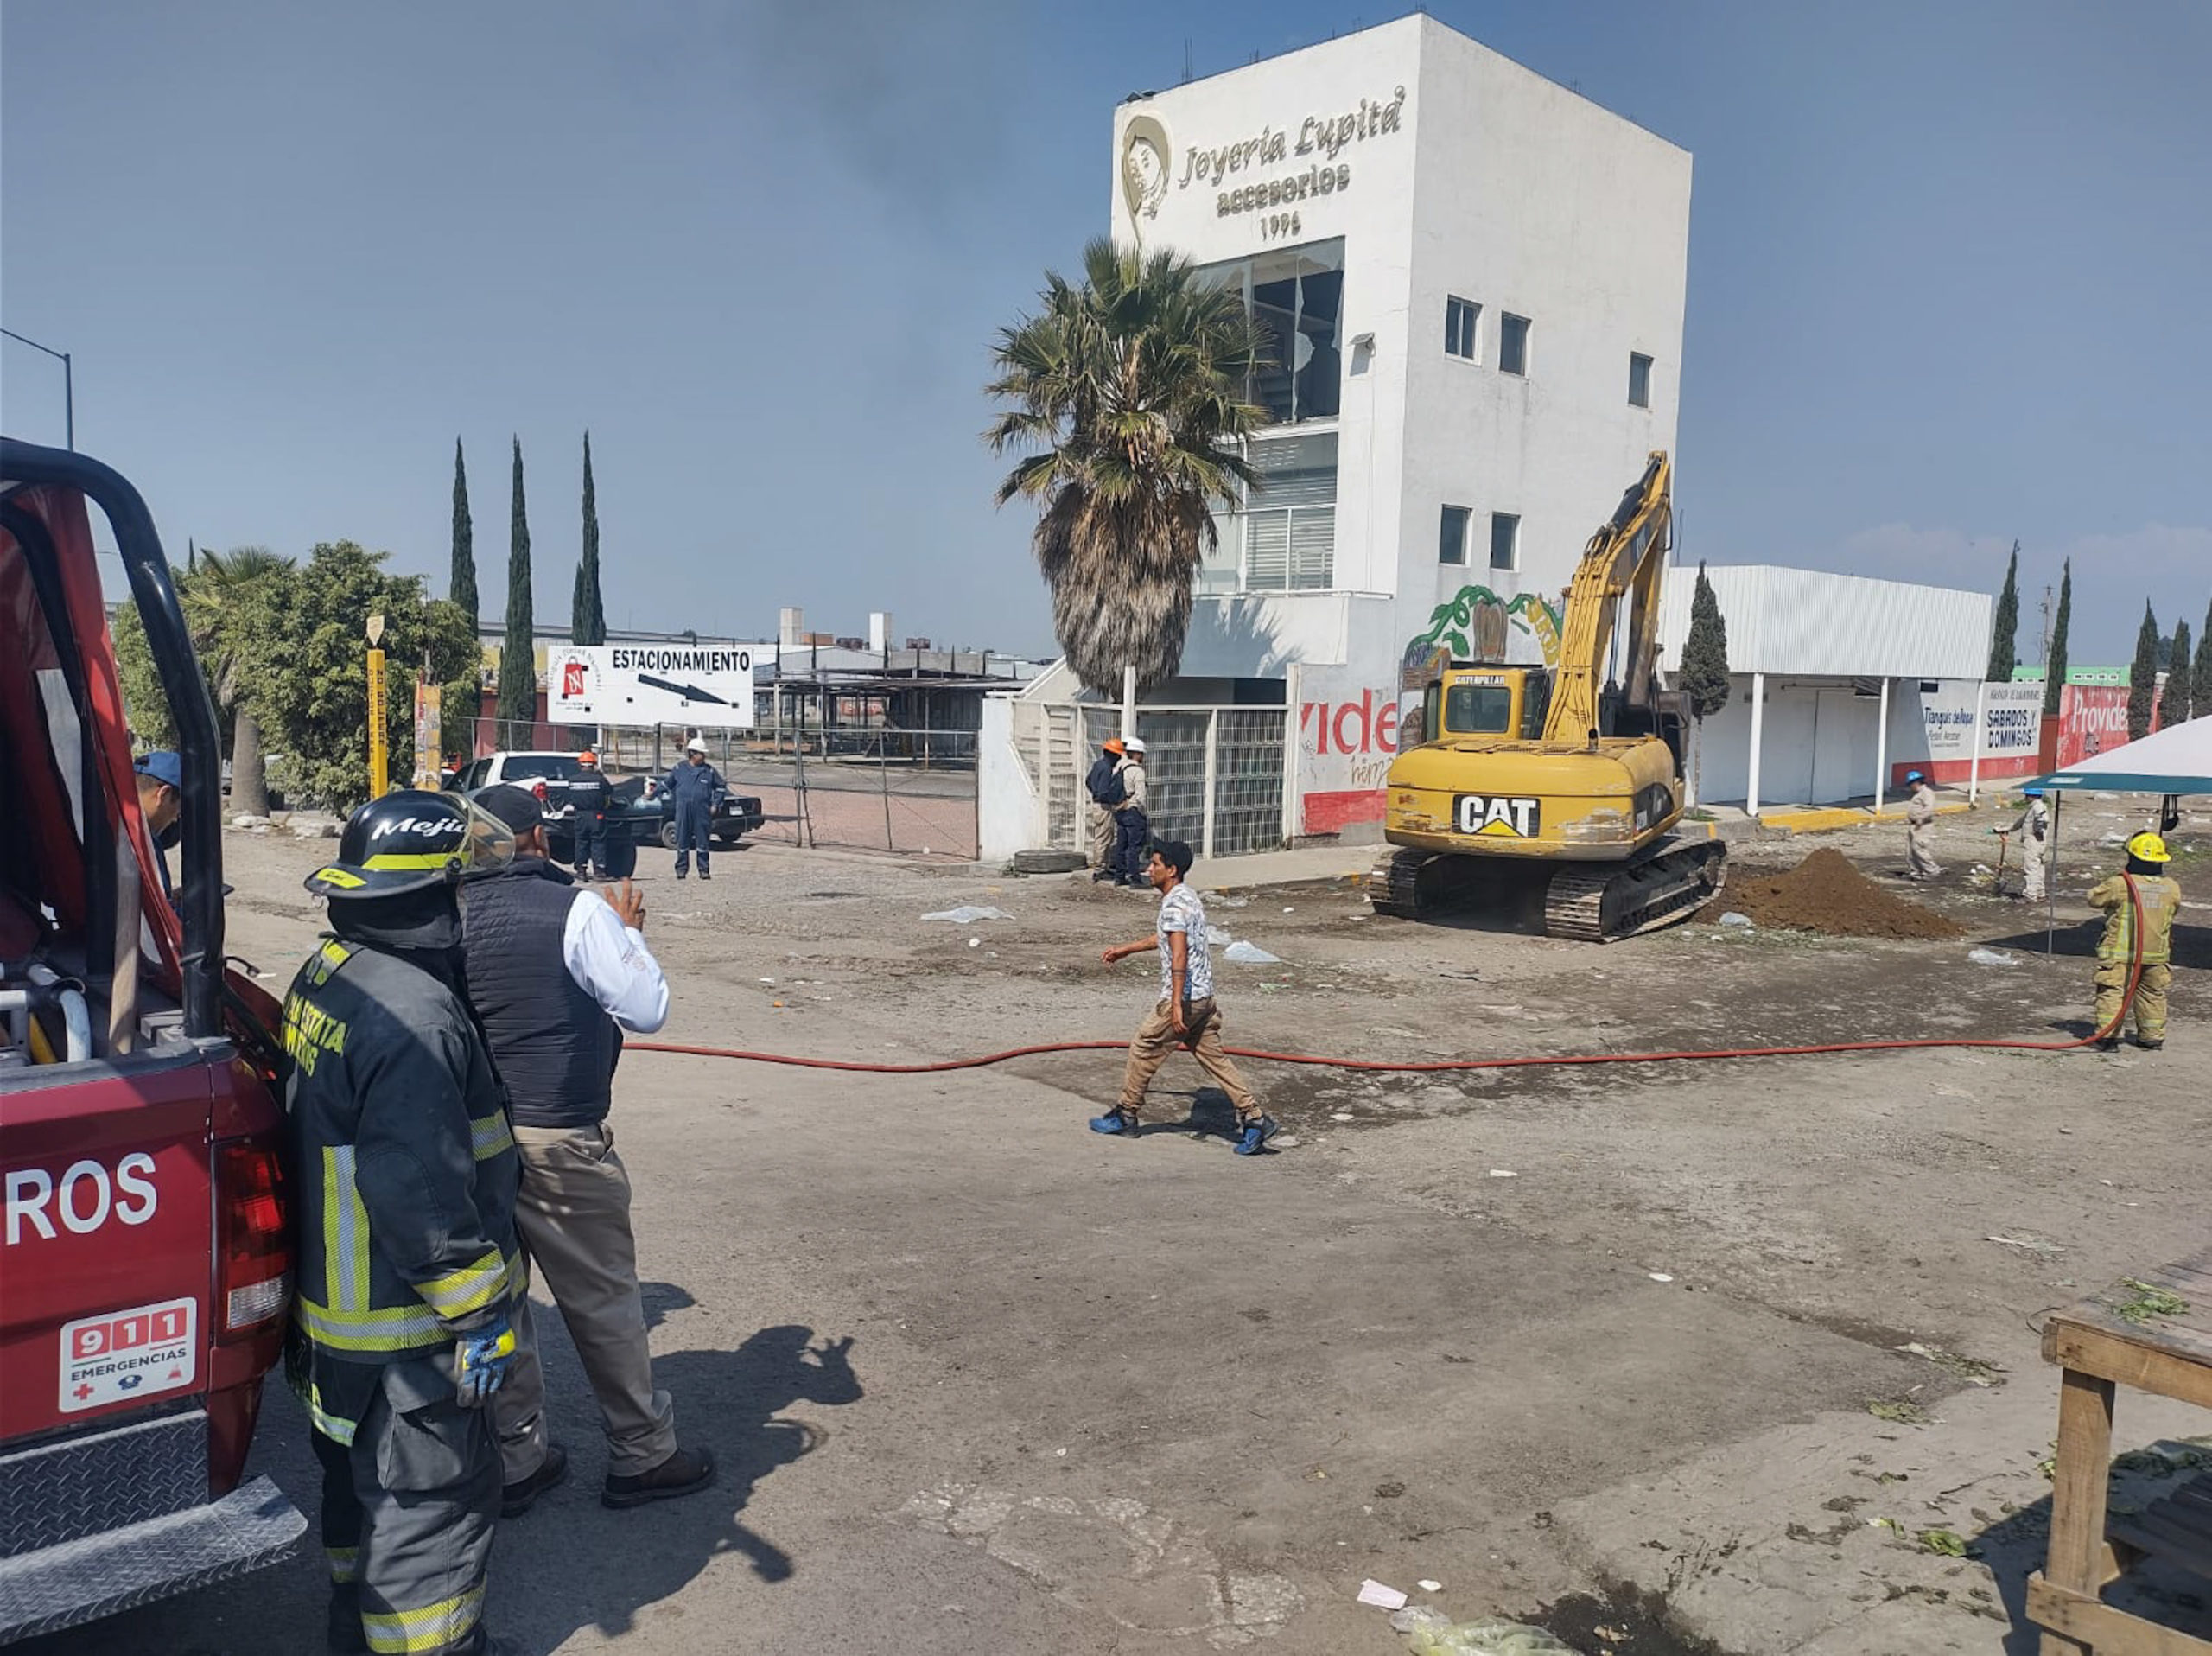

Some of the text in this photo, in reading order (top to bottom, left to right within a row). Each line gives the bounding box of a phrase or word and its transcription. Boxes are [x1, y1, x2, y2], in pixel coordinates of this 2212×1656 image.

[1294, 95, 1402, 161] Lupita
[1217, 163, 1350, 218] accesorios
[613, 649, 750, 672] ESTACIONAMIENTO
[1987, 710, 2027, 728] SABADOS
[1460, 796, 1536, 838] CAT
[5, 1152, 158, 1245] ROS
[80, 1312, 177, 1354] 911
[71, 1347, 187, 1382] EMERGENCIAS
